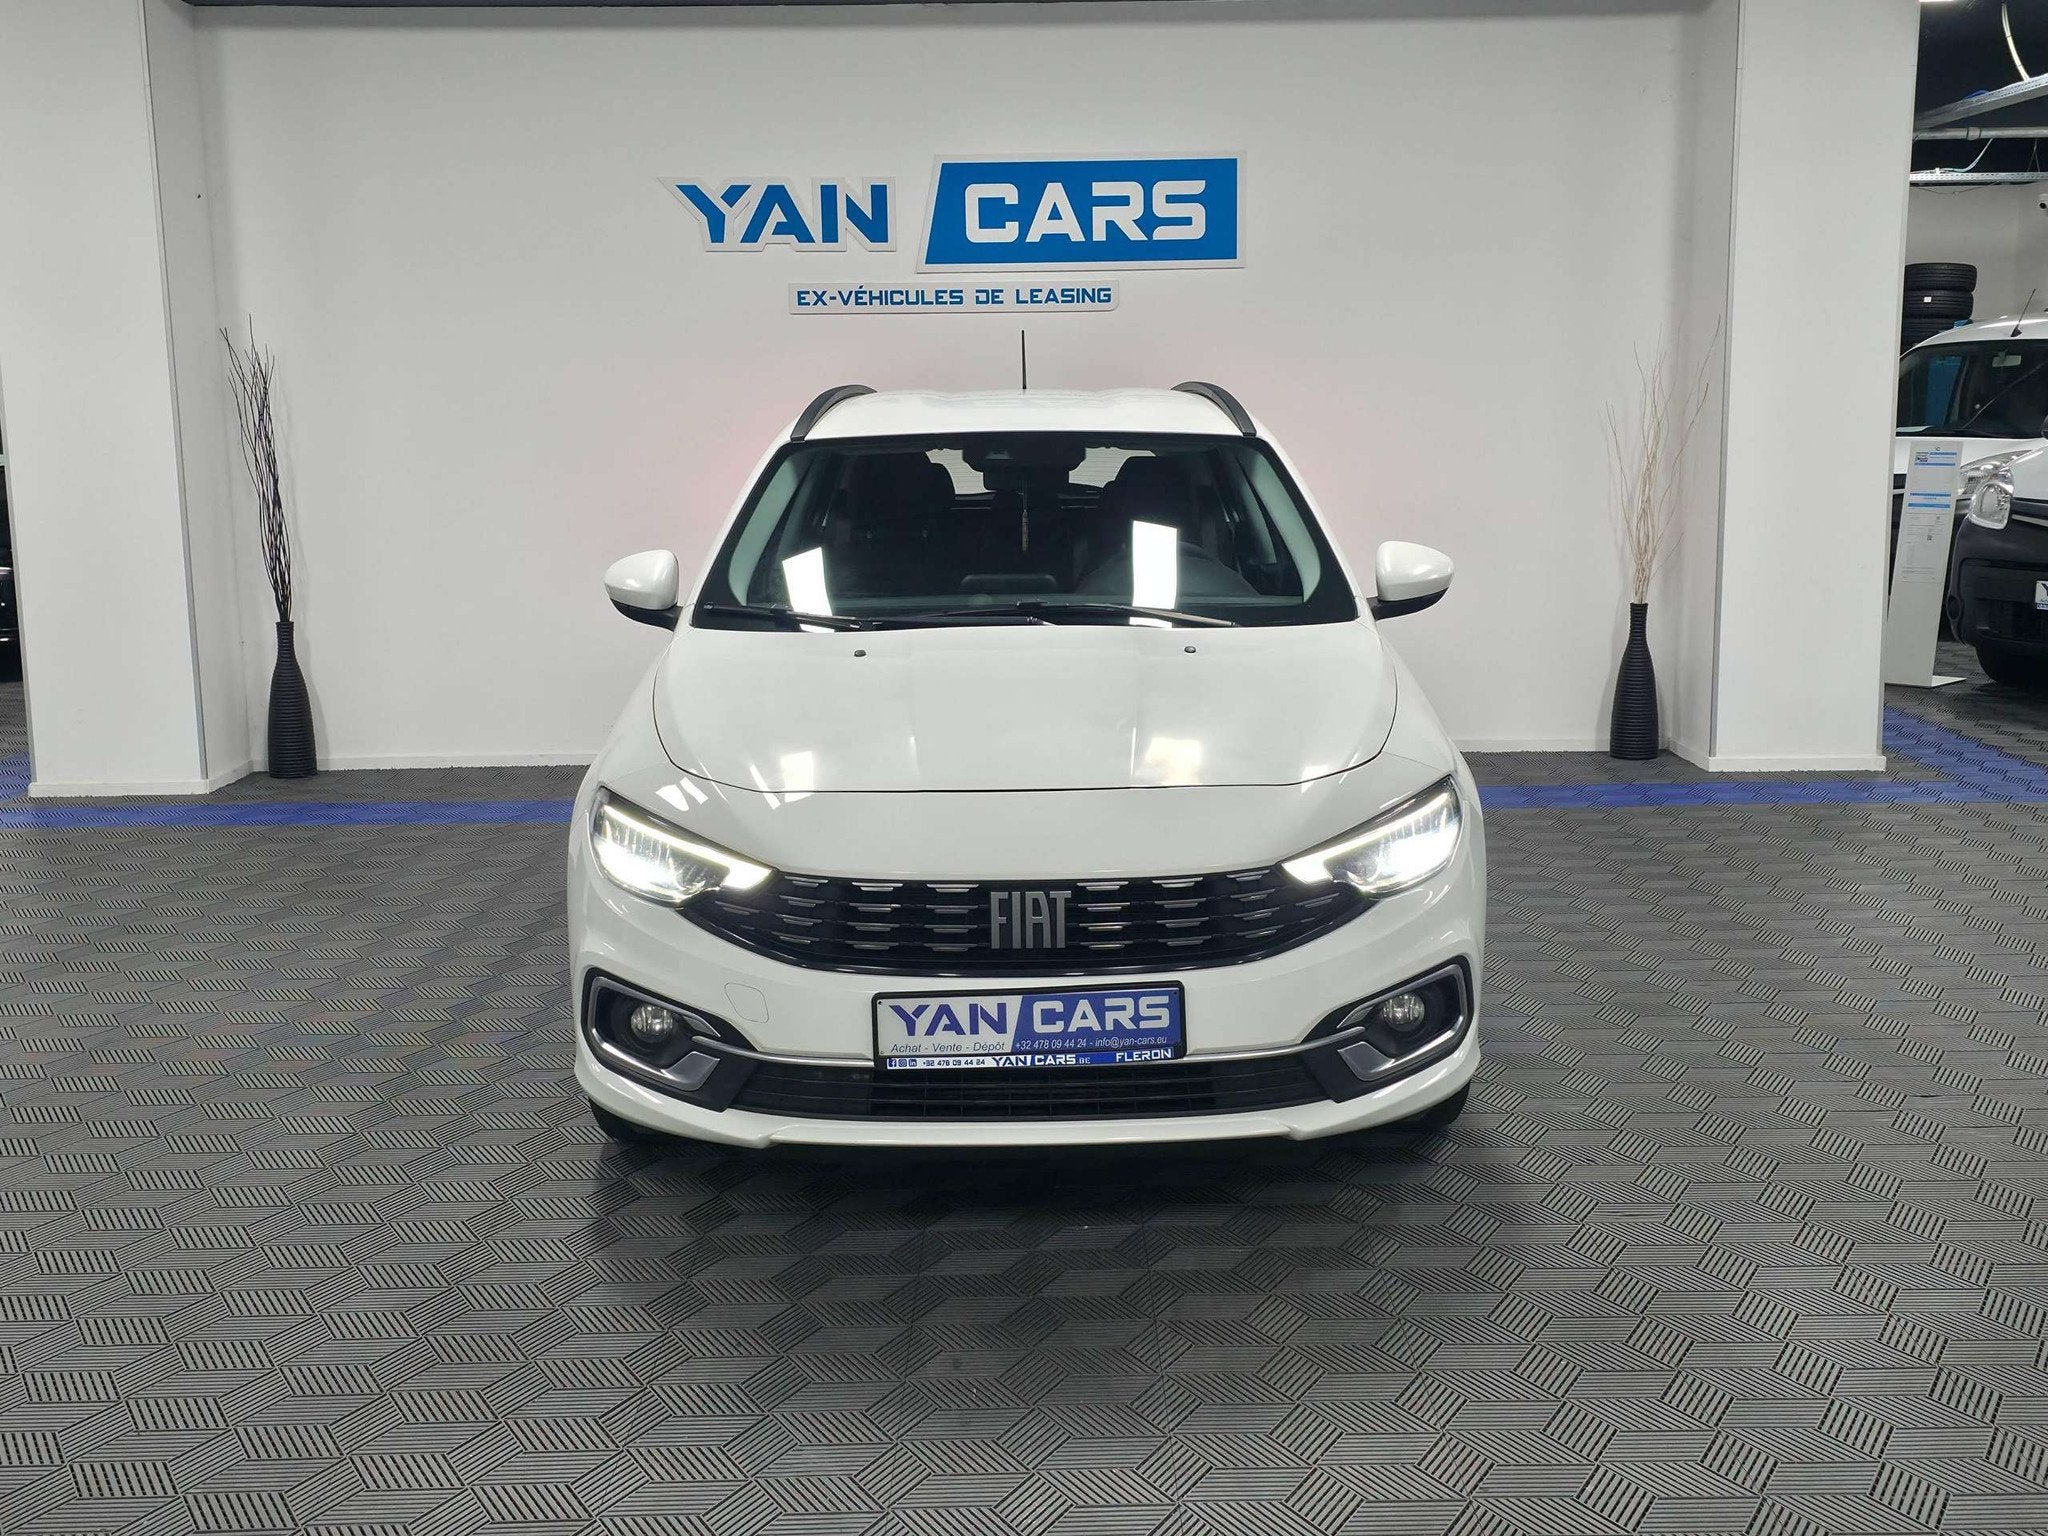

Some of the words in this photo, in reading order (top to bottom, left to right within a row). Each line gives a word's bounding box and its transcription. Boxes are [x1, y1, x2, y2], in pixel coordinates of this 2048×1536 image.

[676, 184, 888, 243] YAN
[965, 180, 1207, 243] CARS
[796, 285, 964, 306] EX-VÉHICULES
[975, 289, 1004, 305] DE
[1015, 287, 1112, 304] LEASING
[990, 890, 1072, 949] FIAT
[889, 1002, 1008, 1036] YAN
[1032, 995, 1170, 1034] CARS
[890, 1043, 922, 1053] Achat
[932, 1042, 963, 1053] Vente
[973, 1041, 1006, 1054] Dépôt
[1015, 1040, 1031, 1051] +32
[1033, 1039, 1049, 1050] 478
[1052, 1039, 1062, 1049] 09
[1064, 1038, 1075, 1048] 44
[1077, 1037, 1087, 1048] 24
[1095, 1036, 1168, 1050] info@yan-cars.eu
[937, 1059, 950, 1067] 478
[952, 1059, 962, 1067] 09
[964, 1058, 974, 1066] 44
[976, 1058, 986, 1066] 24
[991, 1055, 1028, 1067] YAN
[1115, 1048, 1172, 1062] FLERON
